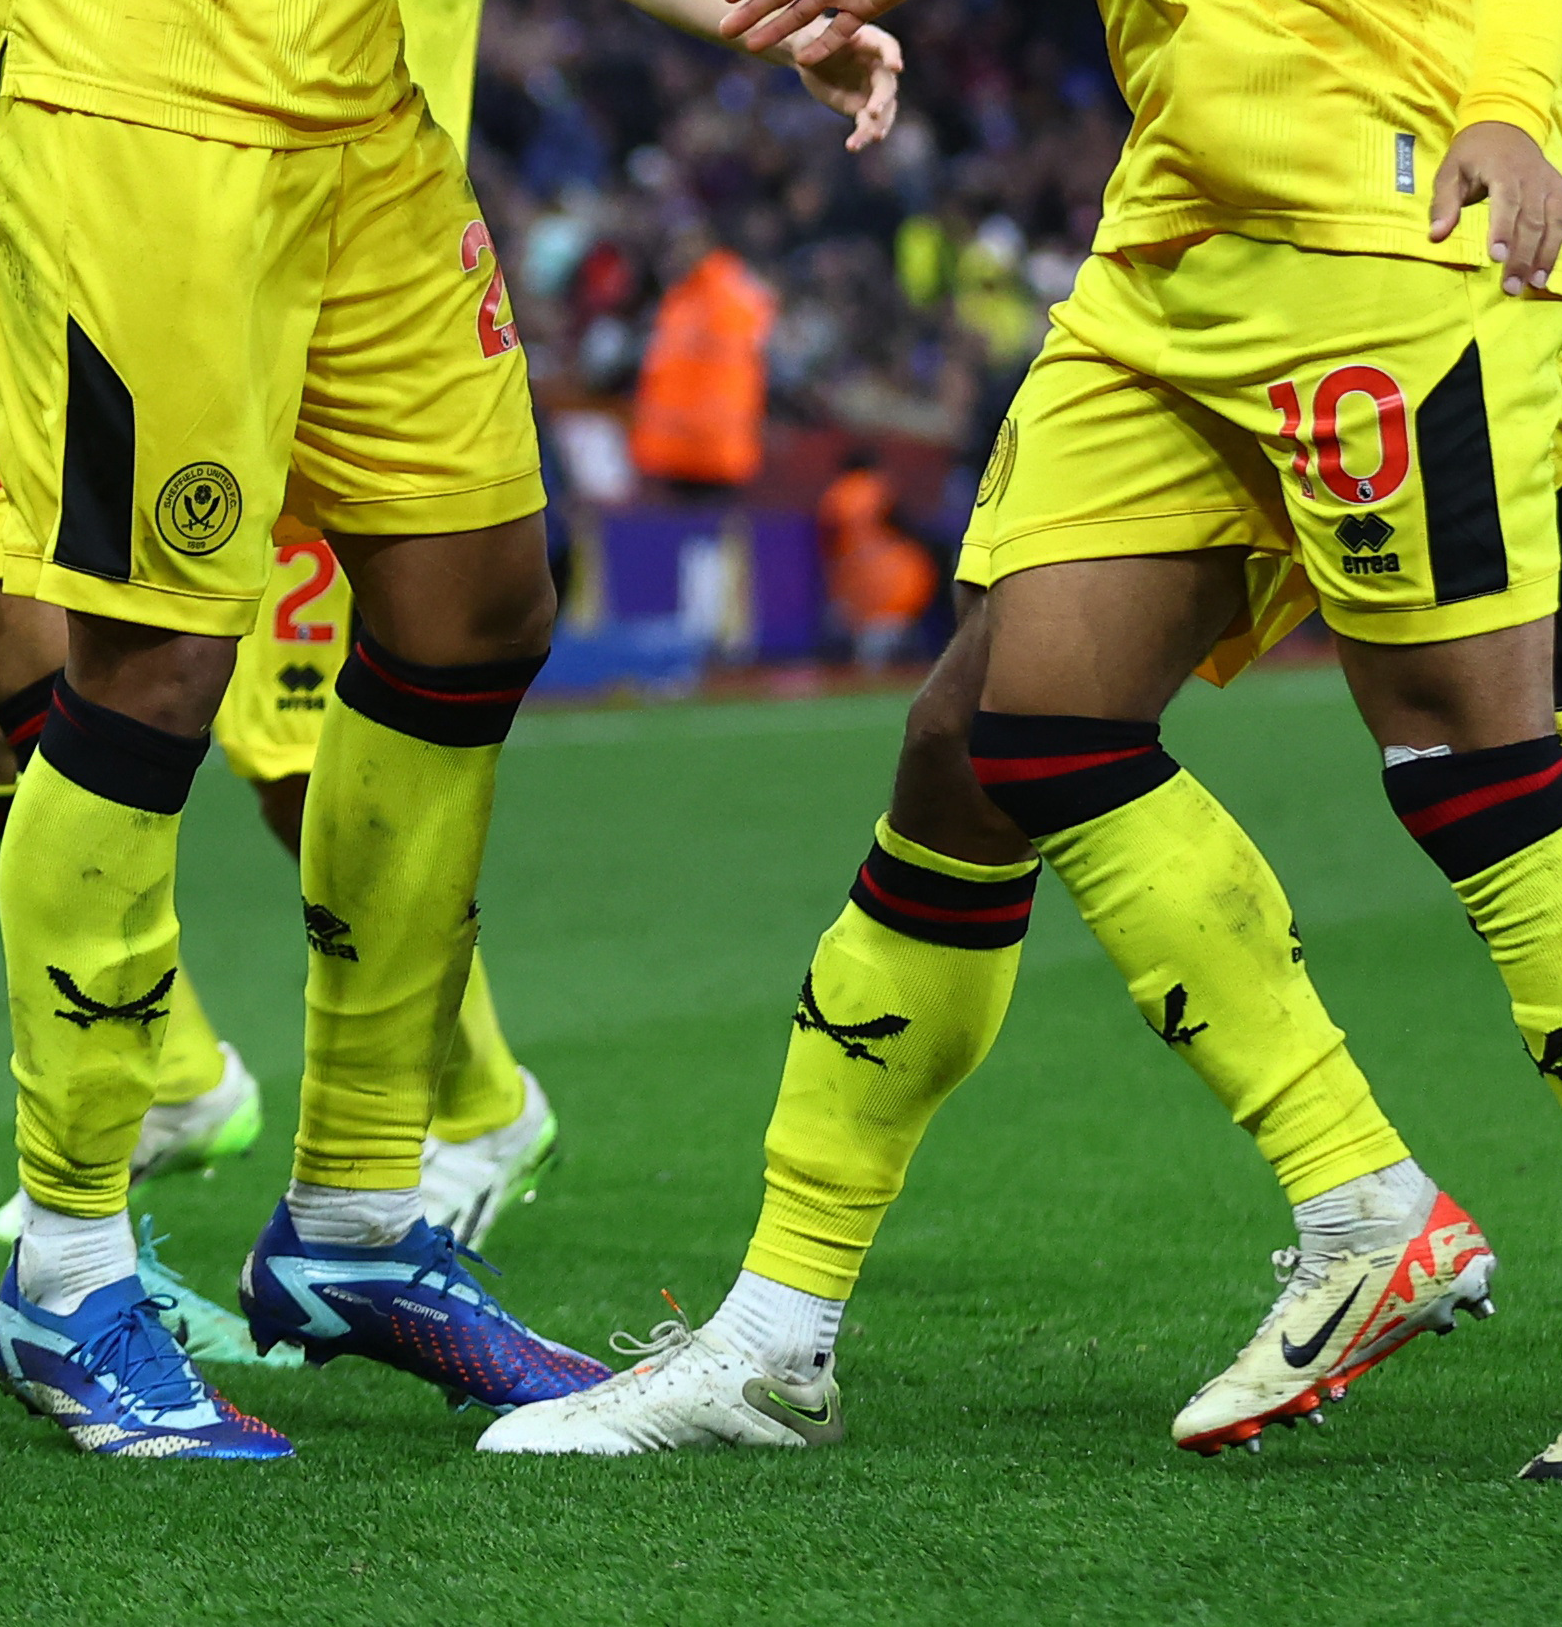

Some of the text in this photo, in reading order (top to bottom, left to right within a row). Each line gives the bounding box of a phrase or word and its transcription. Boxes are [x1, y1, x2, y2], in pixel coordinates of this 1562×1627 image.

[1267, 363, 1410, 506] 10
[164, 468, 203, 508] SHEFFIELD
[274, 539, 337, 642] 2
[1342, 552, 1400, 575] errea
